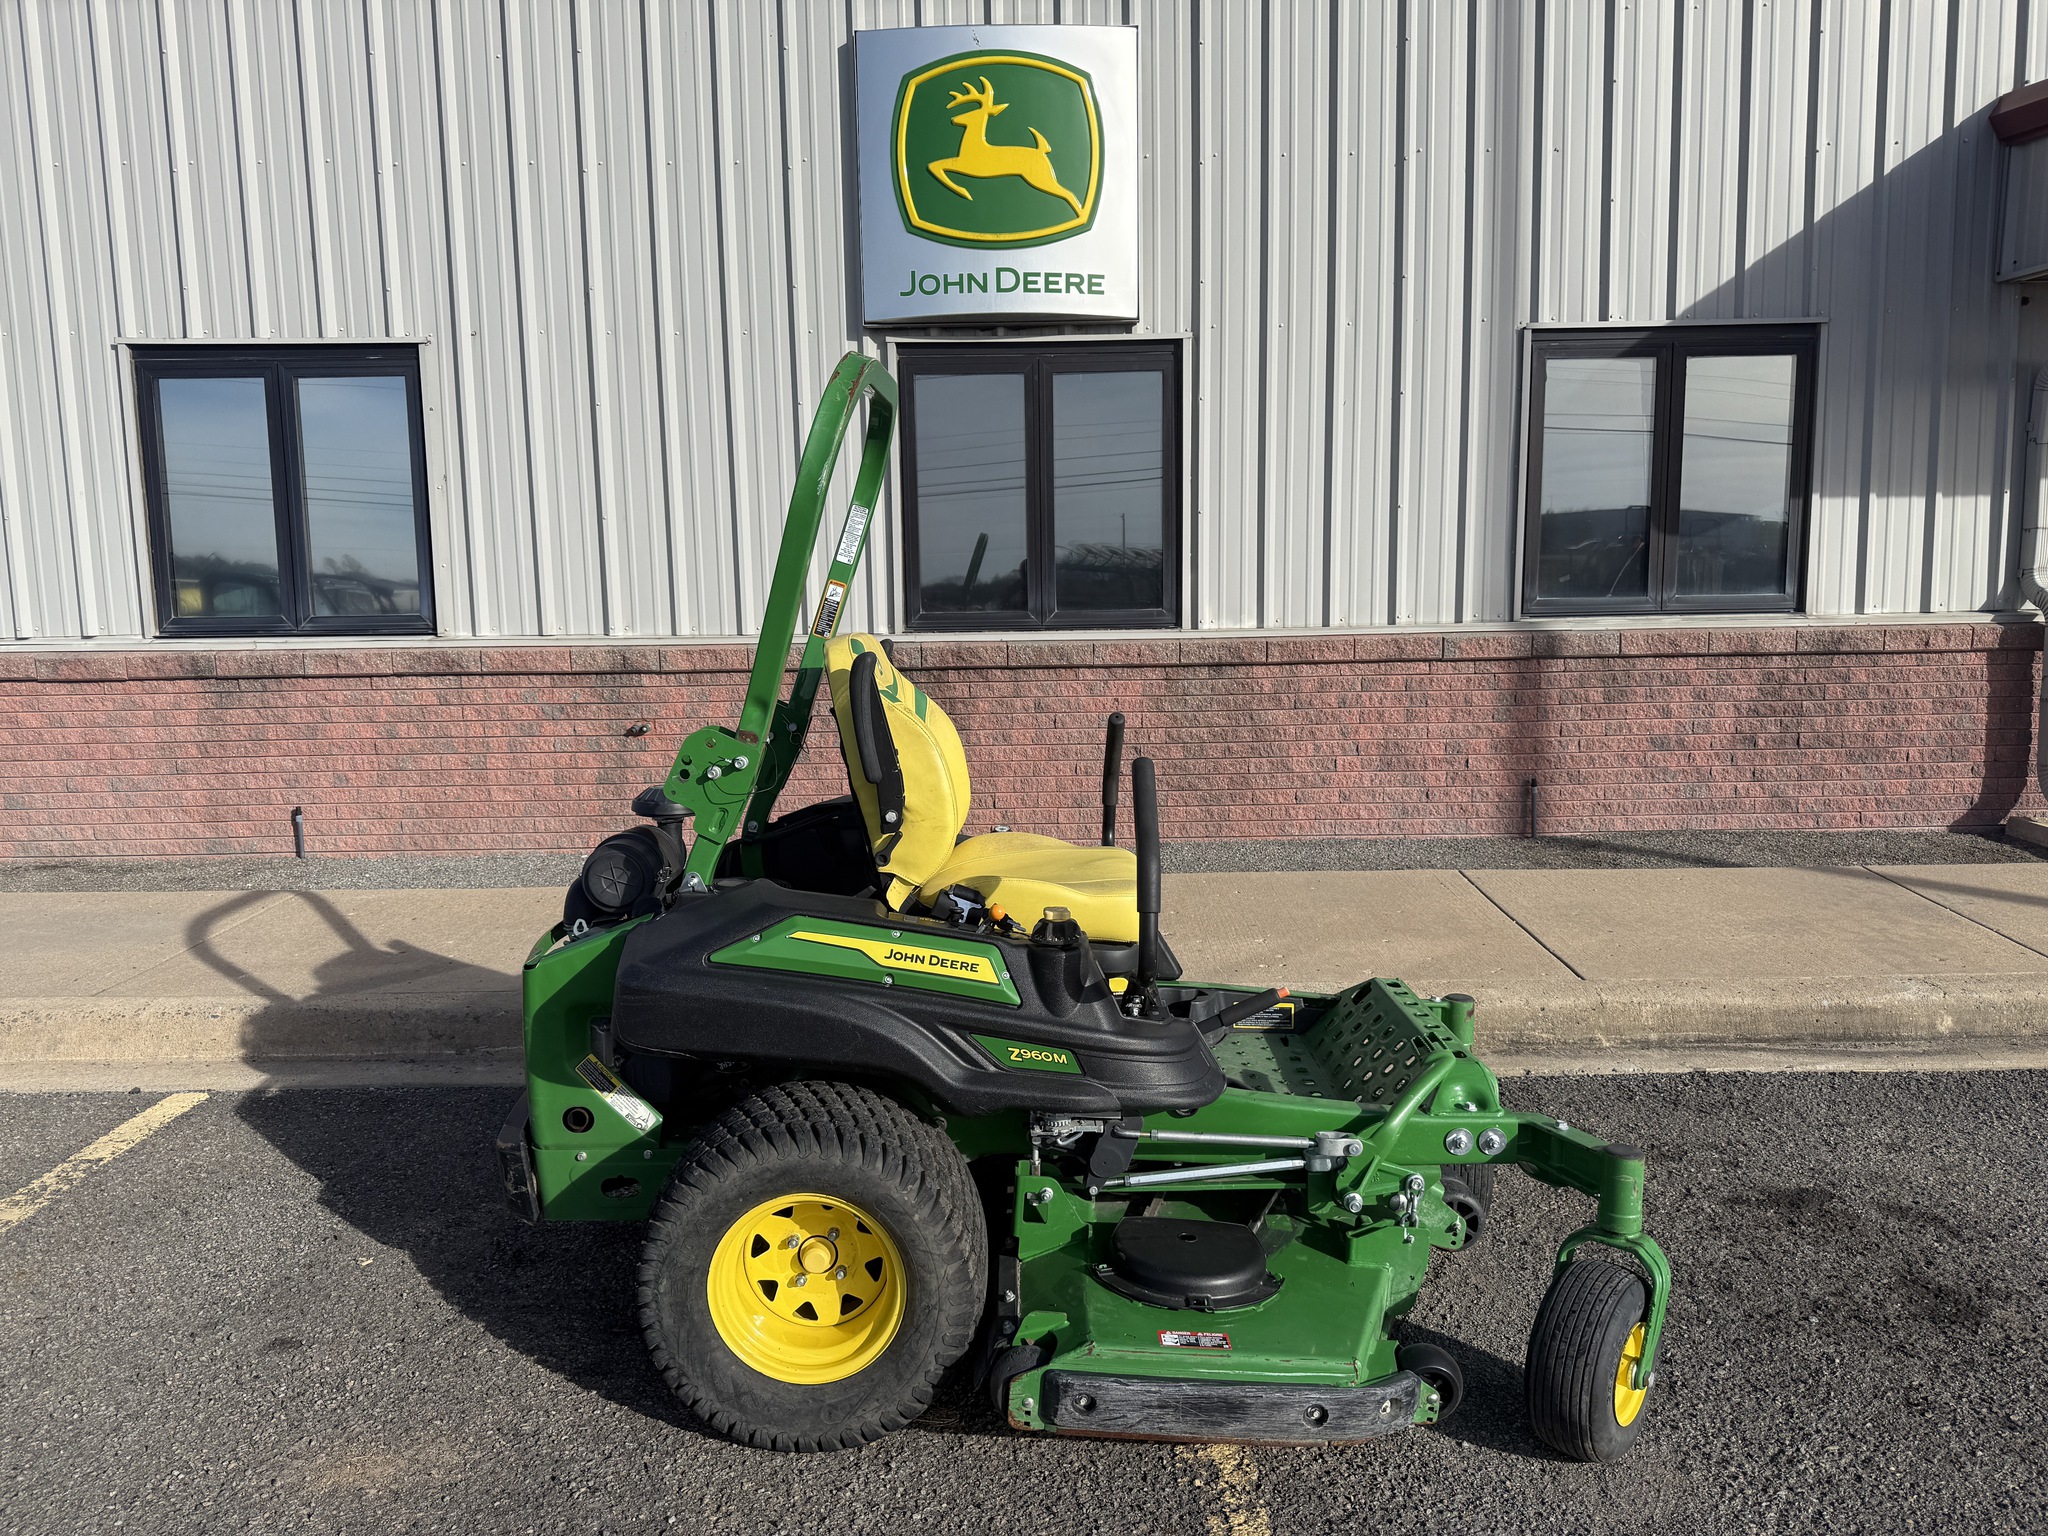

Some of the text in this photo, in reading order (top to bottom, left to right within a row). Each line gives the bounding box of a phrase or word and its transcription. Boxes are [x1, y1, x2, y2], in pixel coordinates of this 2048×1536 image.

[899, 267, 1105, 297] JOHN DEERE
[884, 948, 979, 973] JOHN DEERE
[1007, 1046, 1067, 1065] Z960M
